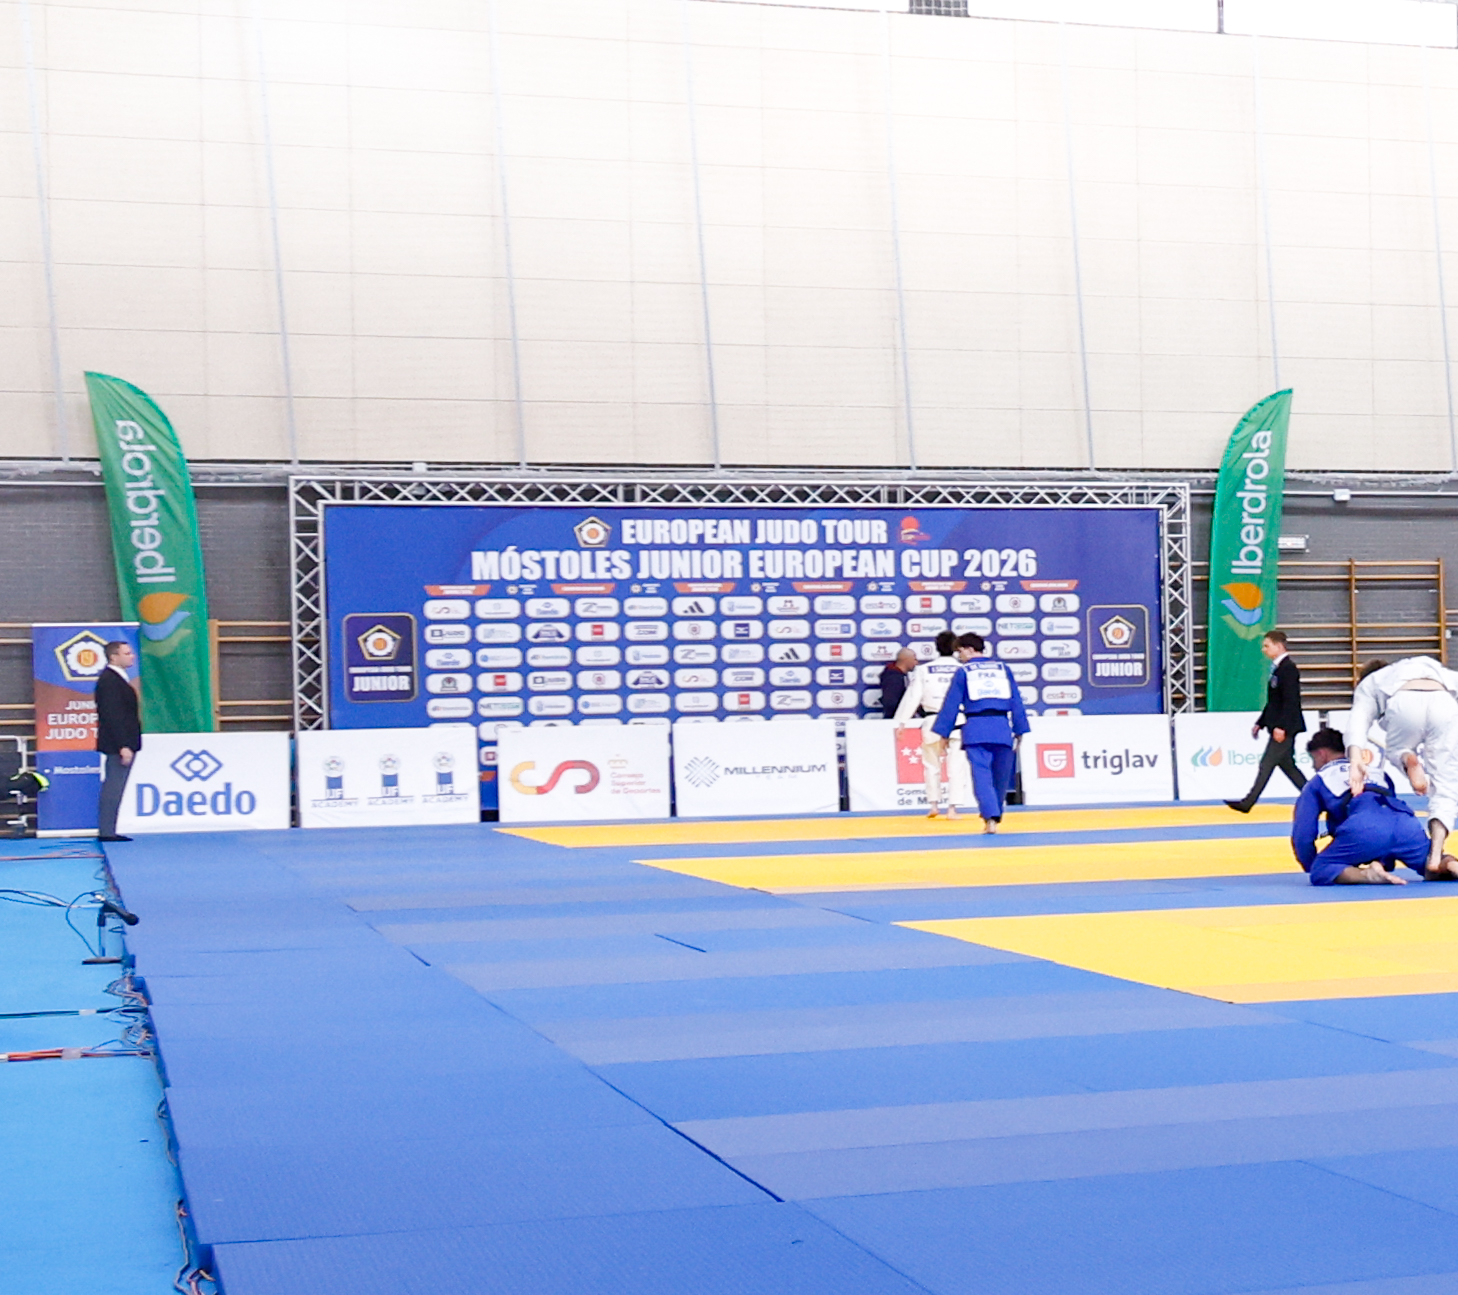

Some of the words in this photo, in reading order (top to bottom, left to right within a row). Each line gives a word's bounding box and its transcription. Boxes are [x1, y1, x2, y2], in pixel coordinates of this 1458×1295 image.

[1230, 430, 1273, 575] Iberdrola
[621, 519, 751, 545] EUROPEAN
[755, 519, 818, 545] JUDO
[821, 519, 888, 545] TOUR
[471, 546, 632, 581] MÓSTOLES
[637, 550, 743, 581] JUNIOR
[749, 549, 896, 580] EUROPEAN
[901, 548, 959, 579] CUP
[963, 548, 1038, 579] 2026
[1094, 661, 1144, 678] JUNIOR
[352, 675, 411, 693] JUNIOR
[47, 713, 99, 725] EUROP
[45, 727, 88, 740] JUDO
[724, 764, 827, 776] MILLENNIUM
[1081, 749, 1159, 776] triglav
[135, 782, 257, 817] Daedo
